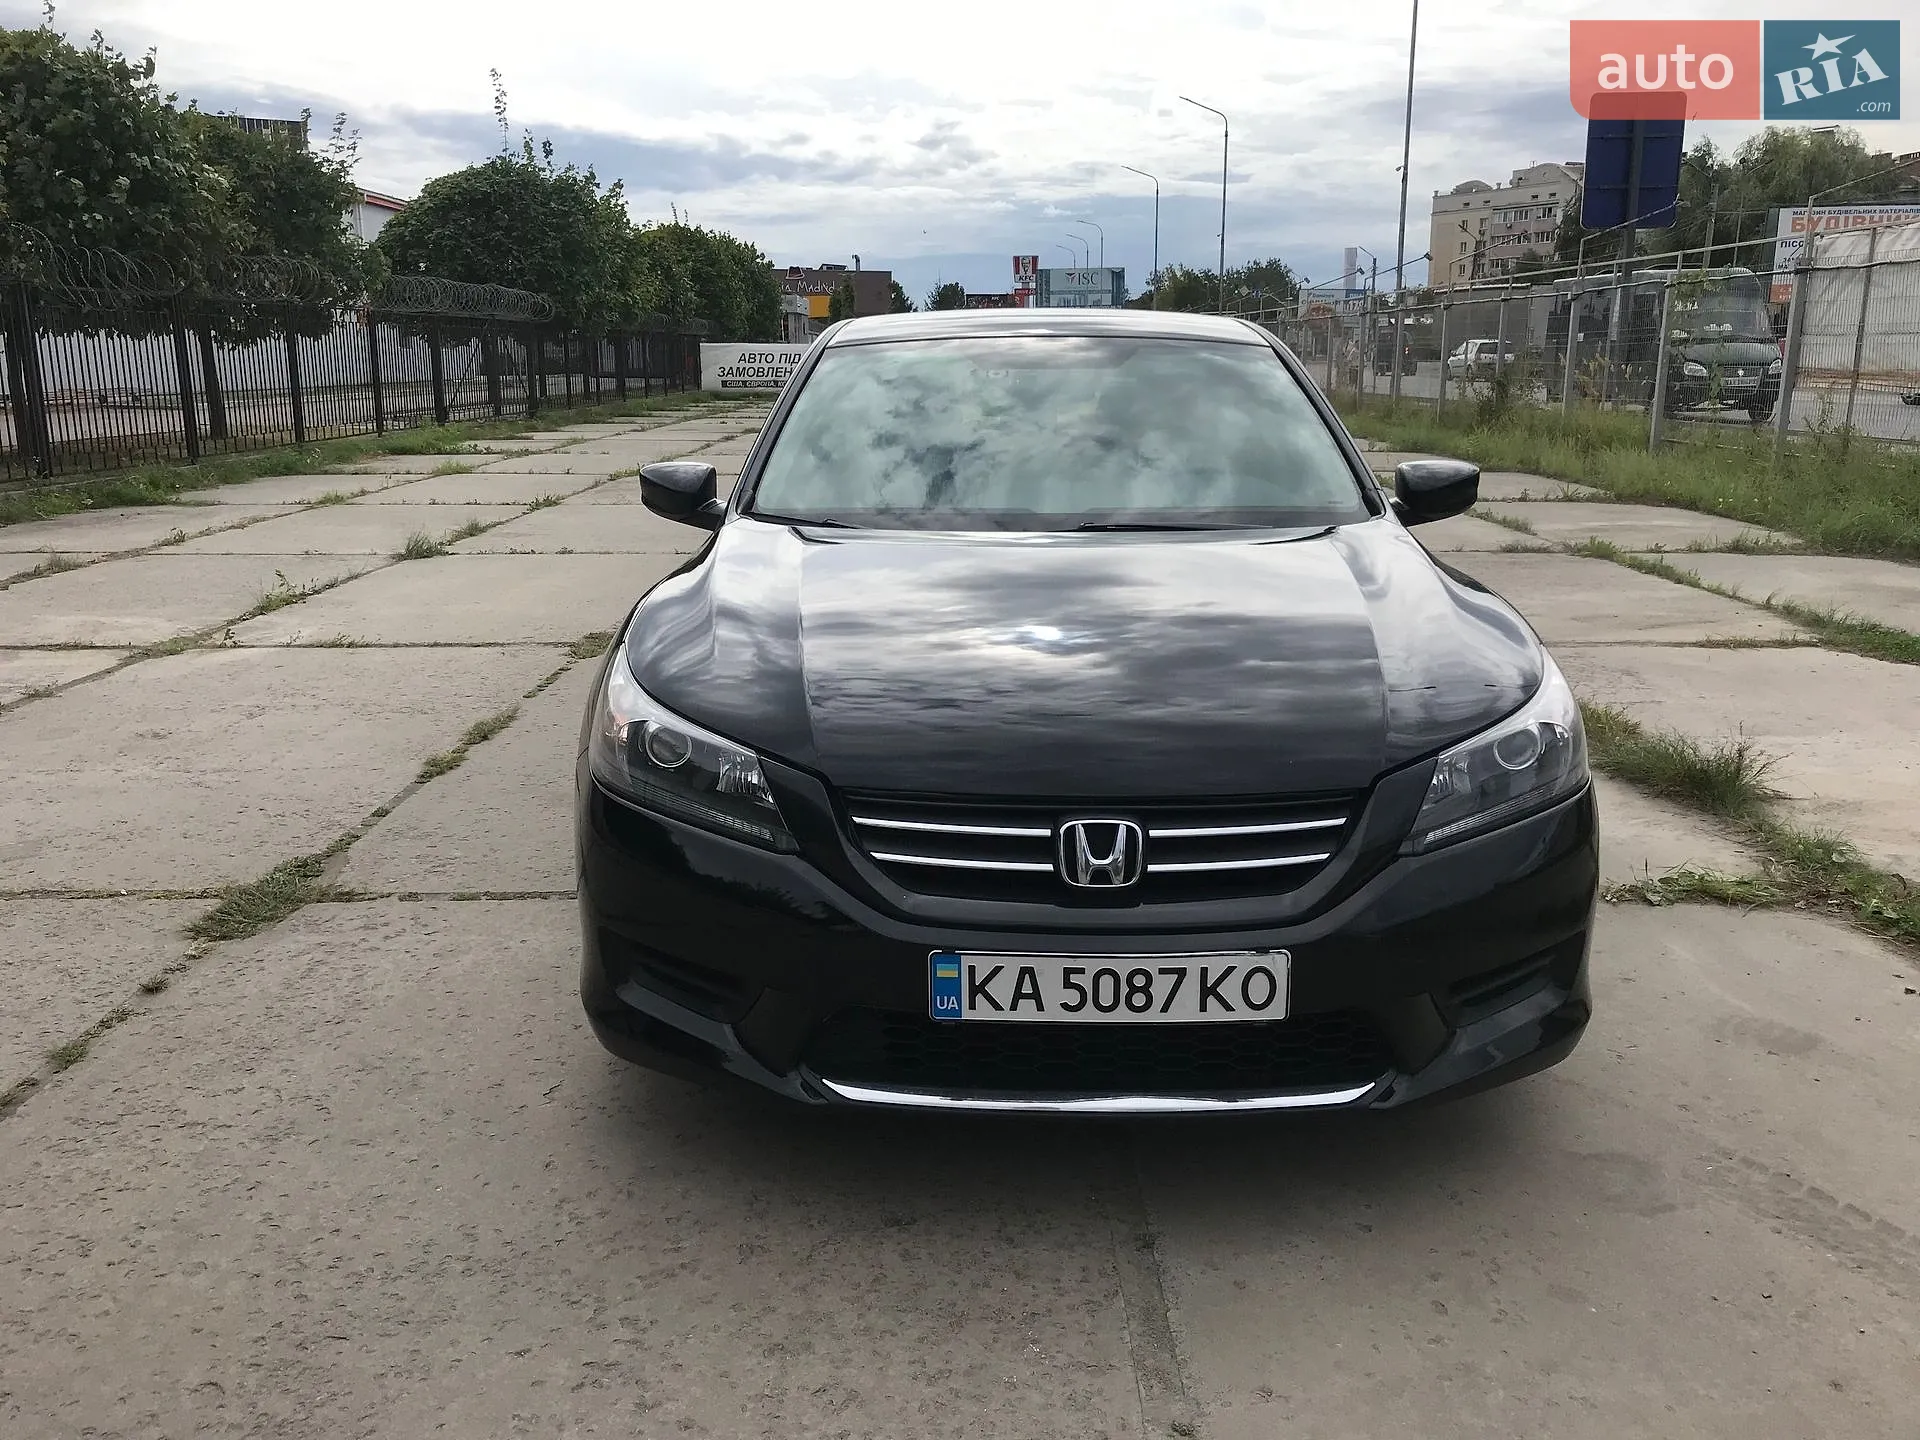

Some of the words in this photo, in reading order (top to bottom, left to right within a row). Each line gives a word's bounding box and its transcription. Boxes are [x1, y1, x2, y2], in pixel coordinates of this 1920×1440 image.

[1077, 272, 1098, 285] ISC
[738, 353, 775, 364] АВТО
[779, 353, 801, 366] ПІД
[717, 367, 794, 378] ЗАМОВЛЕН
[967, 964, 1046, 1013] KA
[1059, 966, 1188, 1014] 5087
[1199, 964, 1278, 1013] KO
[936, 995, 959, 1010] UA
